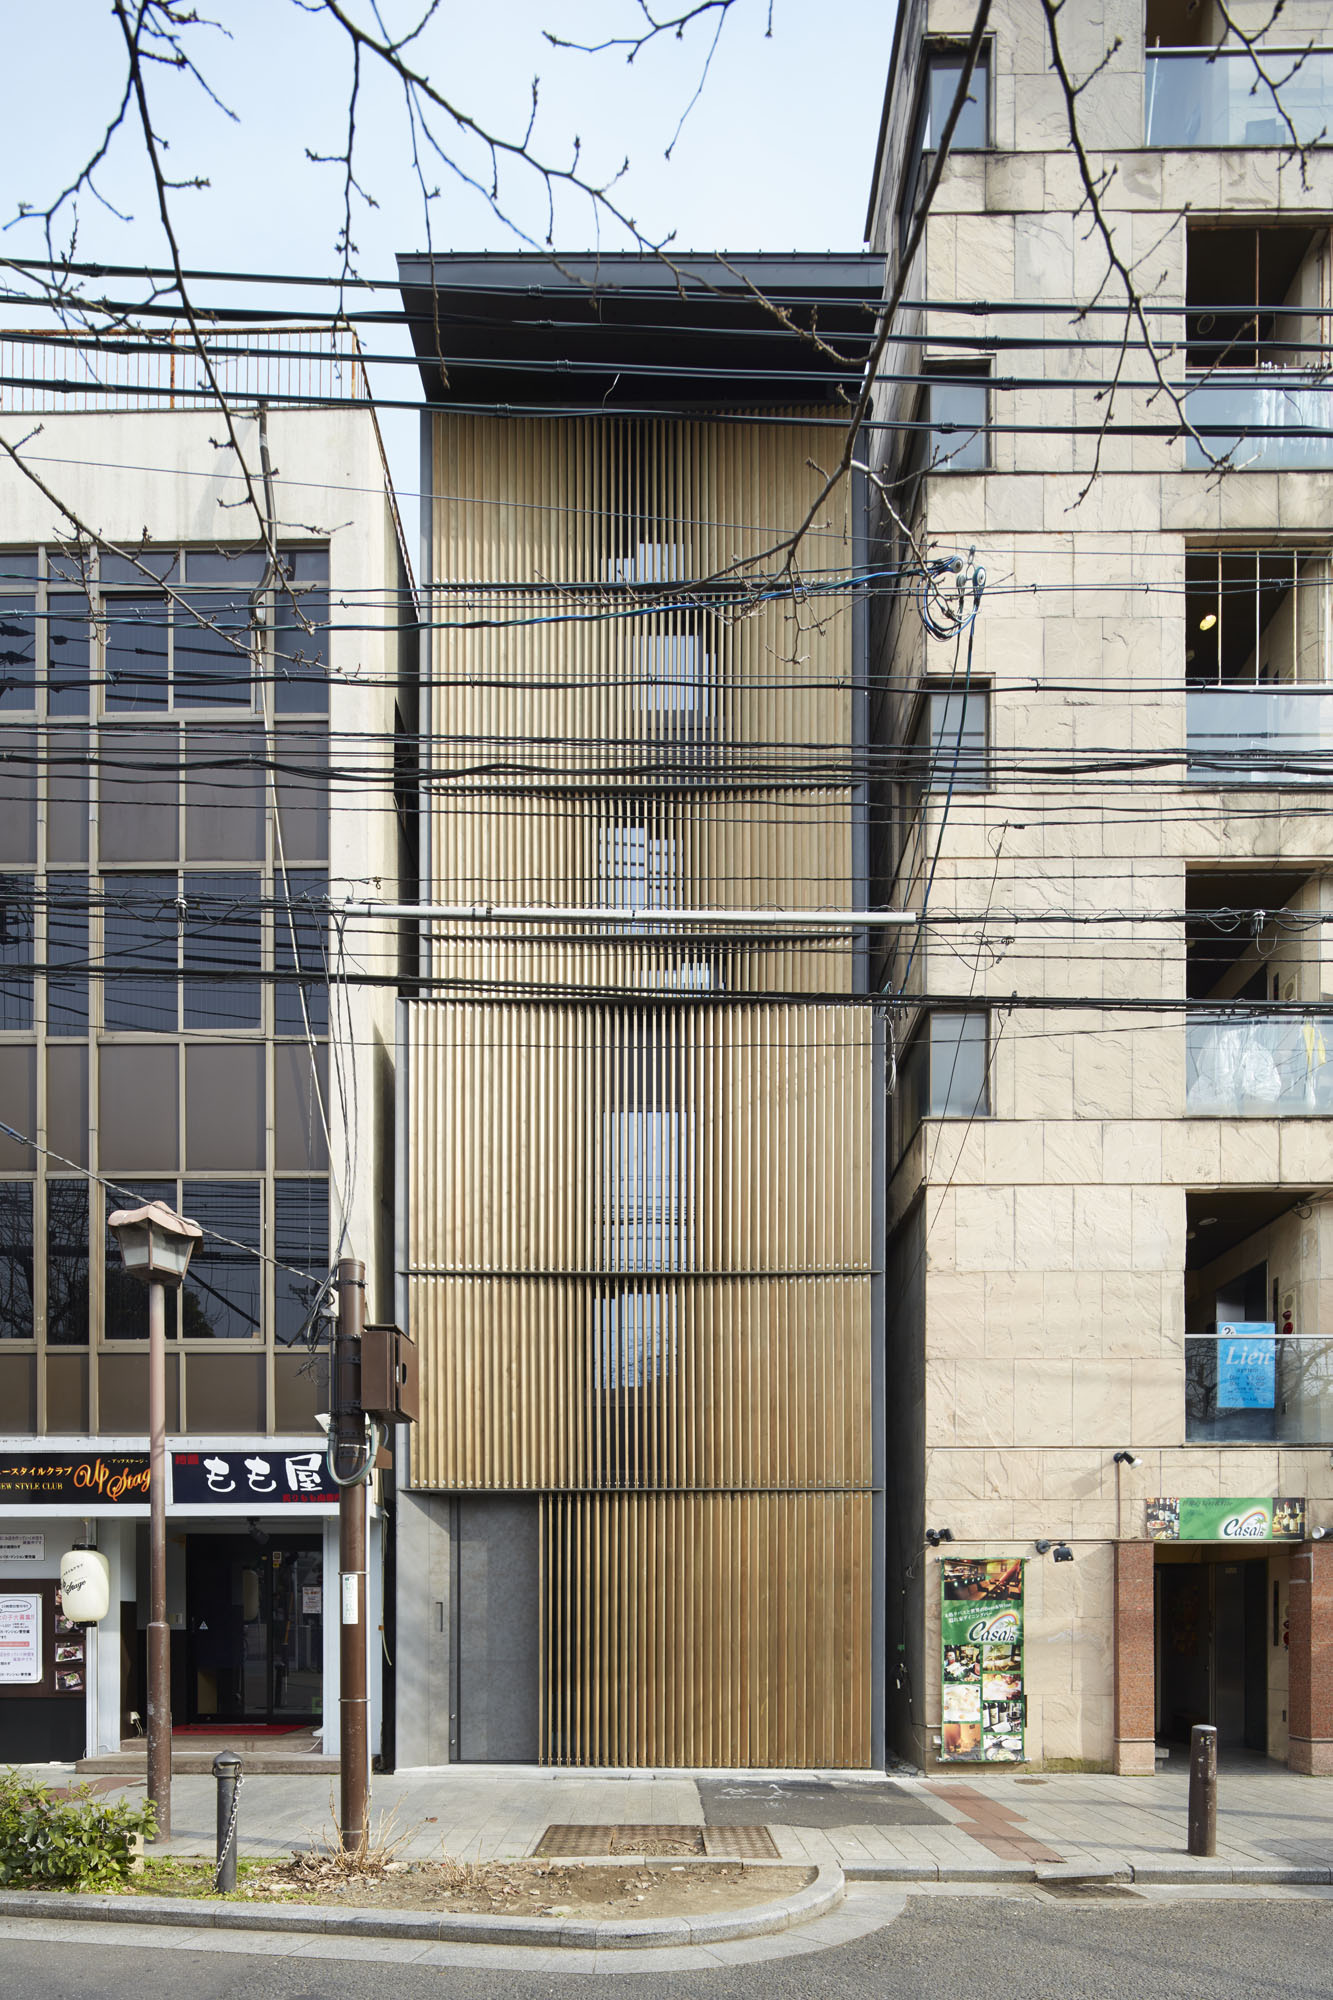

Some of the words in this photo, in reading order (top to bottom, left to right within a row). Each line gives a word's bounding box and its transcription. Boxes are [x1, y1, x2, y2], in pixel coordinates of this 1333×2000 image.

[1226, 1346, 1272, 1365] Lien
[0, 1466, 73, 1477] ースタイルクラブ
[73, 1458, 109, 1494] Up
[106, 1467, 151, 1502] Stag
[203, 1453, 323, 1493] もも屋
[0, 1482, 12, 1491] EW
[15, 1482, 41, 1491] STYLE
[42, 1482, 63, 1491] CLUB
[1223, 1518, 1258, 1537] Casa
[968, 1621, 1010, 1641] Casa
